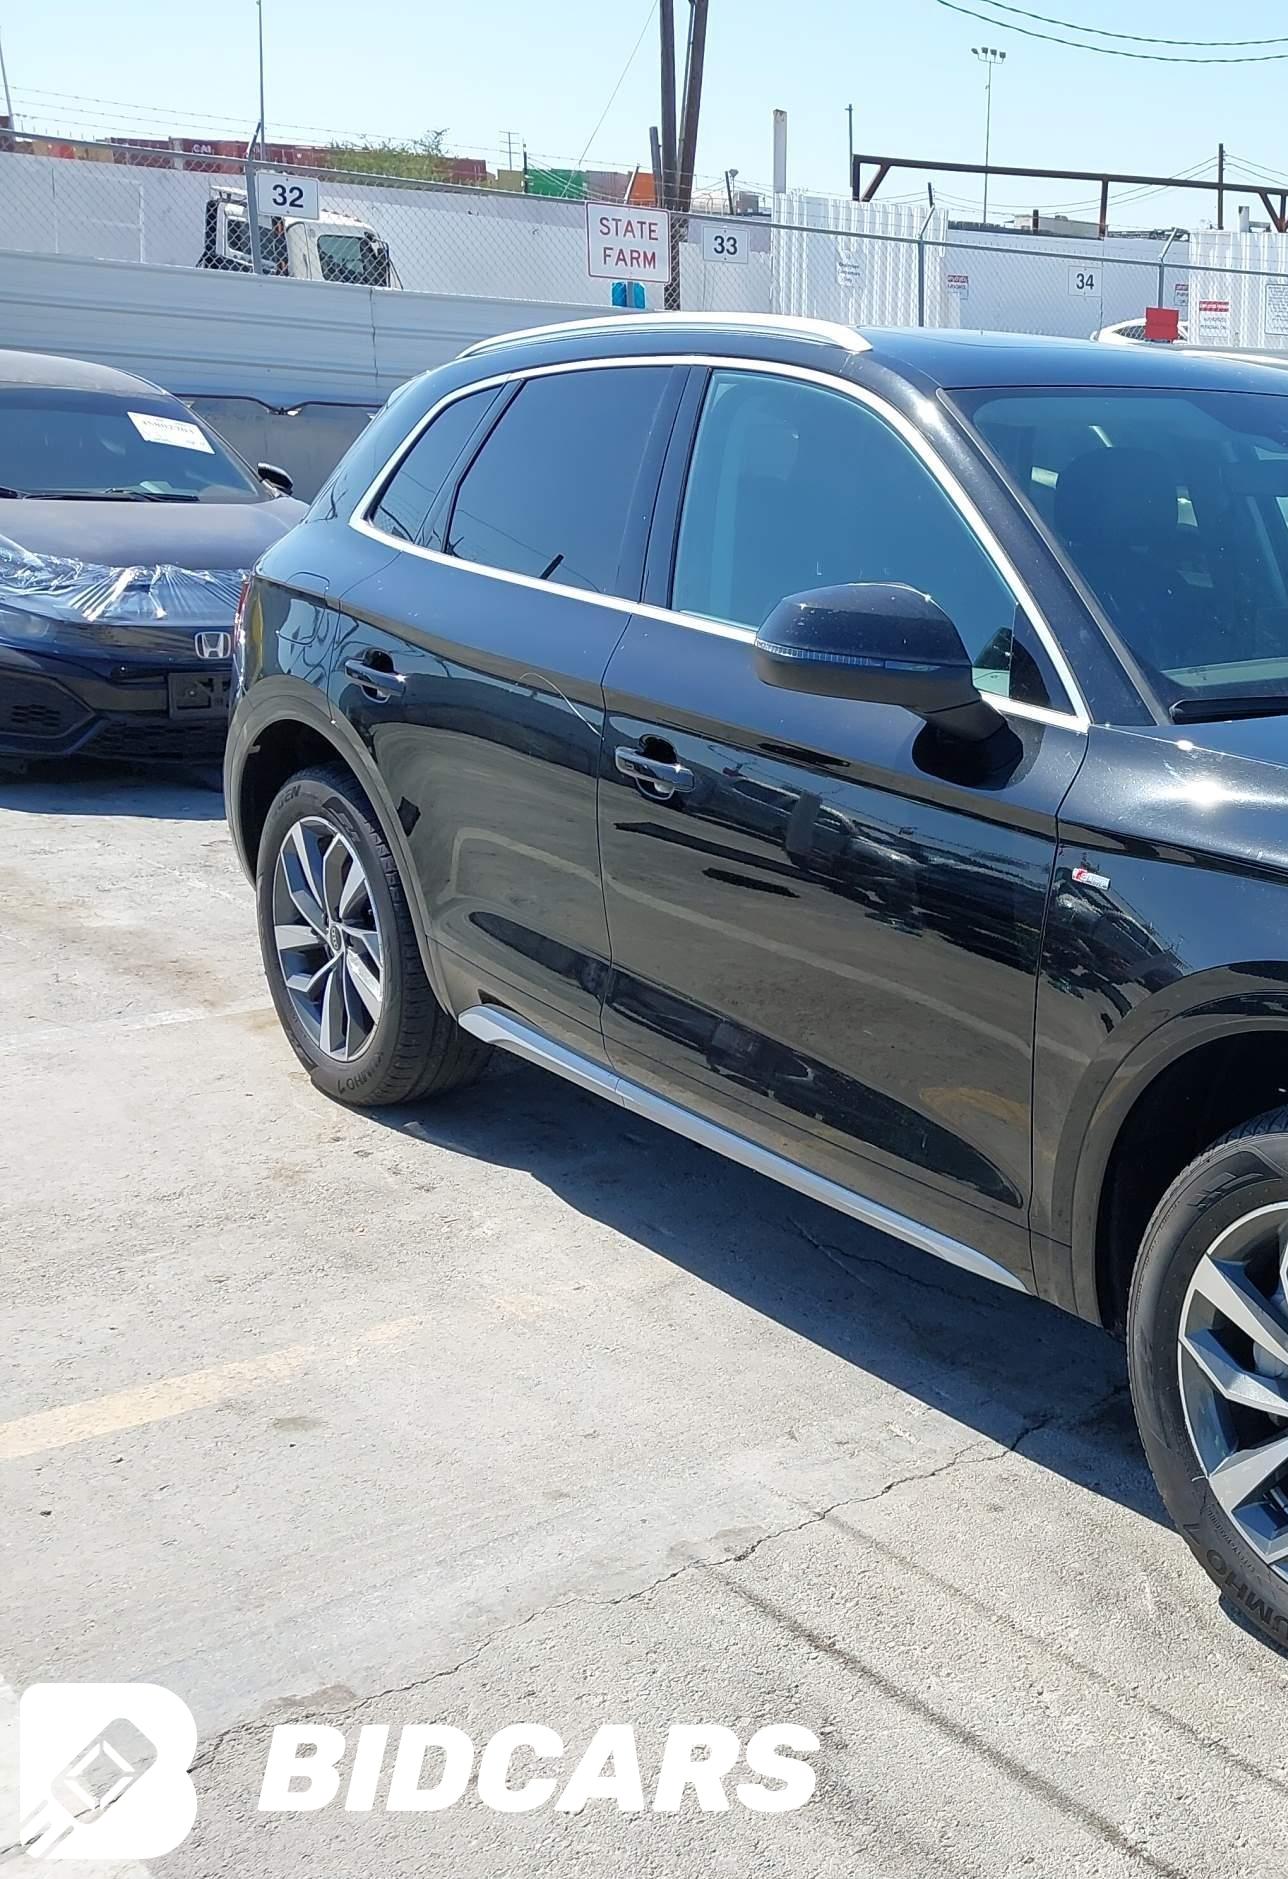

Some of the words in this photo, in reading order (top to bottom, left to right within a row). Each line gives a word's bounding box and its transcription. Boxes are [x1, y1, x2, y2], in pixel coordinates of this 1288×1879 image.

[272, 184, 304, 208] 32
[599, 216, 659, 241] STATE
[713, 235, 738, 256] 33
[603, 246, 656, 270] FARM
[1076, 273, 1095, 290] 34
